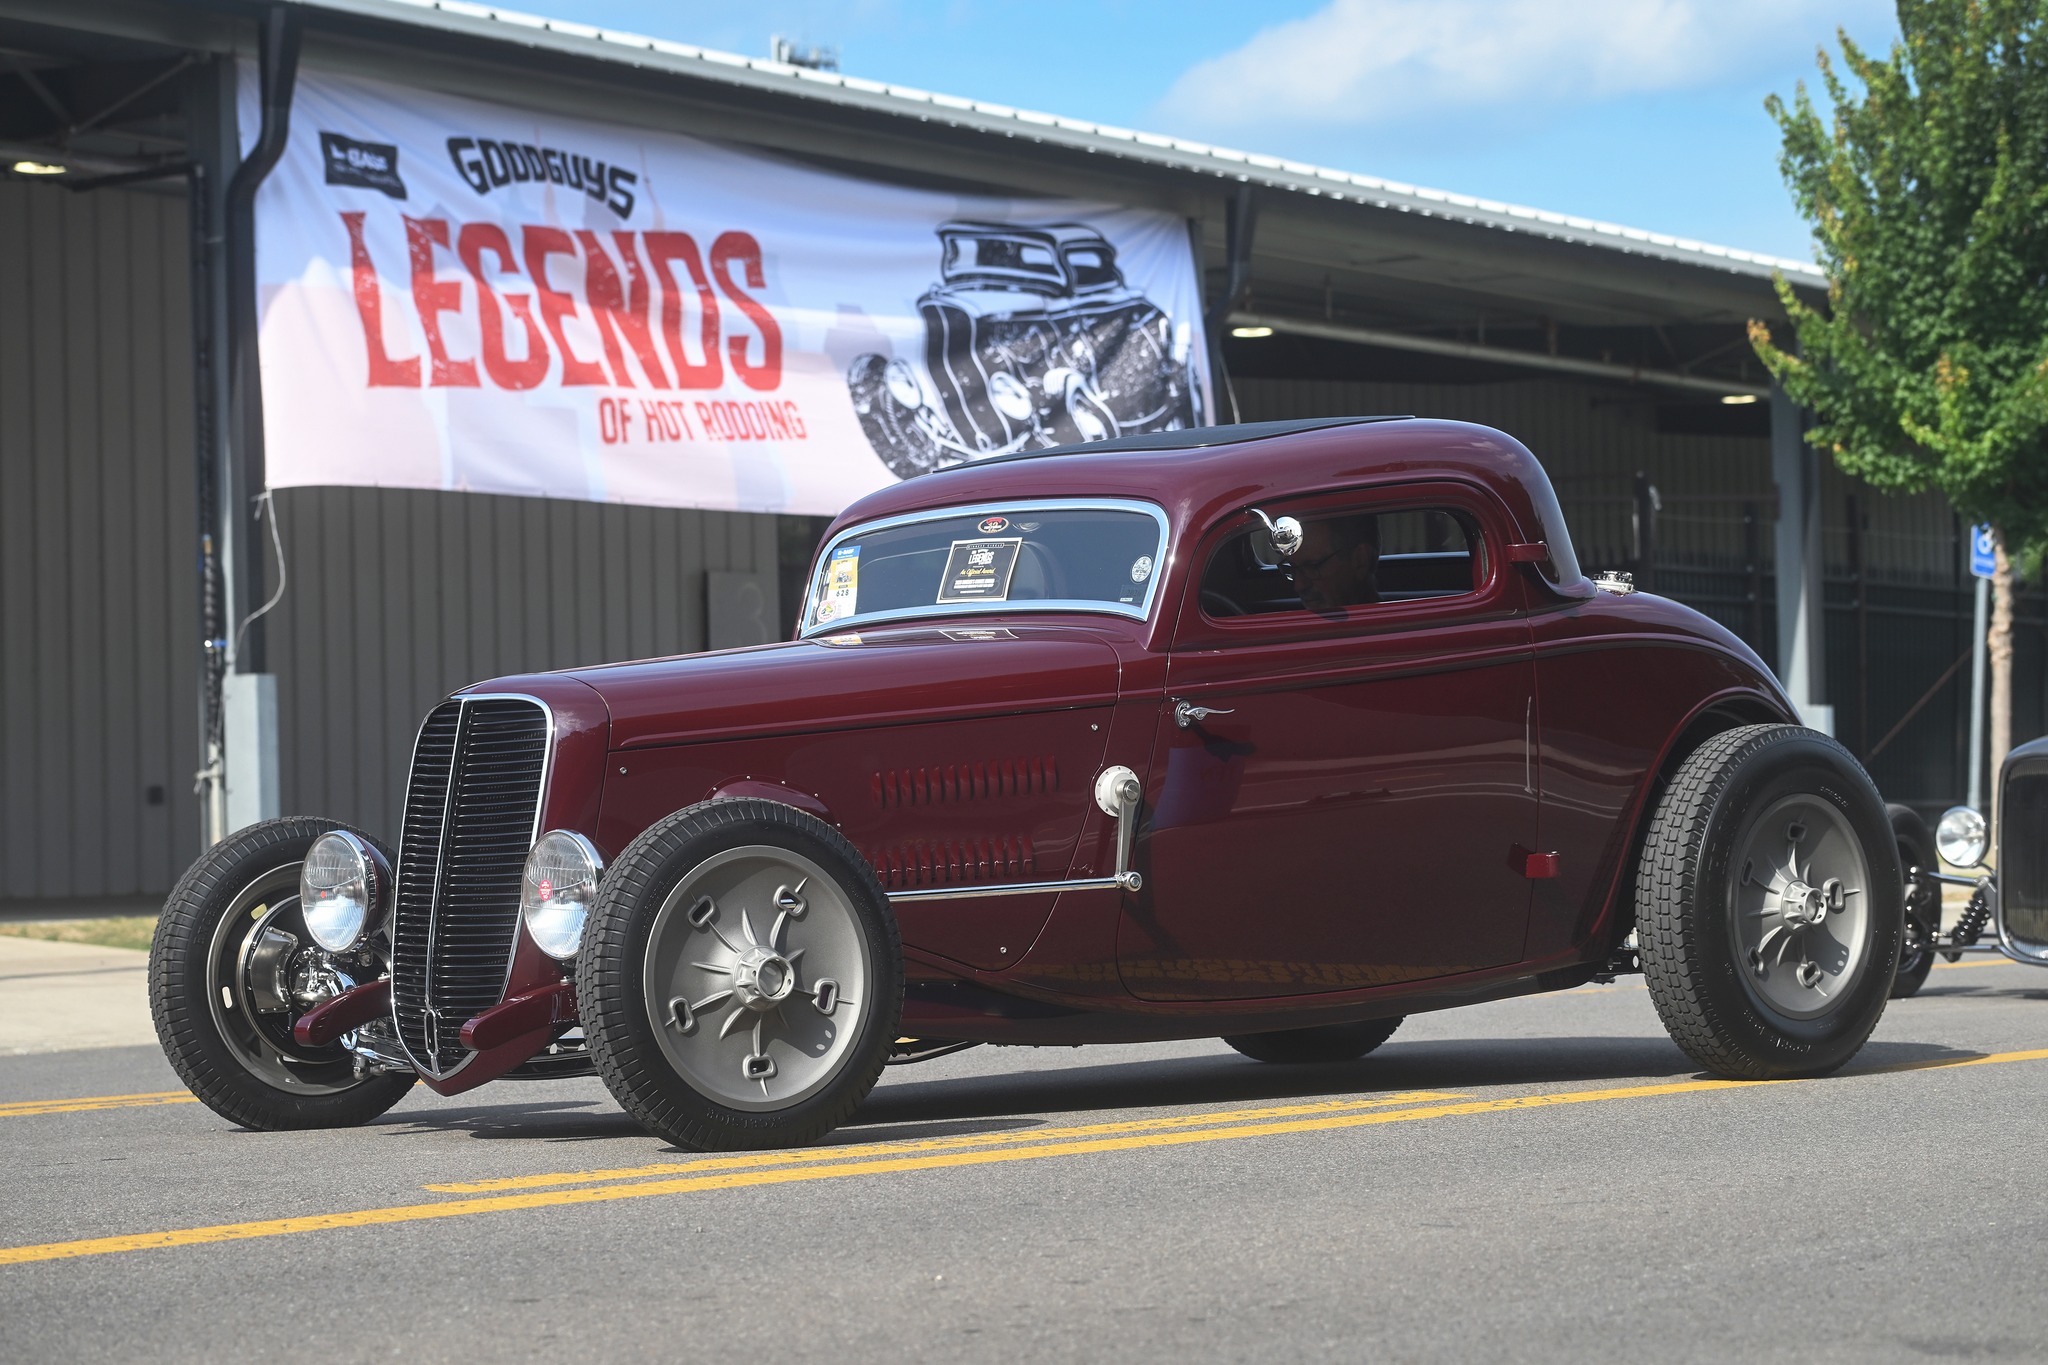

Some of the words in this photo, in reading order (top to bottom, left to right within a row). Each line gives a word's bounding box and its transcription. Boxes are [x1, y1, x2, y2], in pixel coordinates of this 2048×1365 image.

[446, 137, 638, 220] GOODGUYS
[339, 211, 783, 391] LEGENDS
[599, 397, 633, 445] OF
[639, 399, 694, 442] HOT
[694, 400, 808, 442] RODDING
